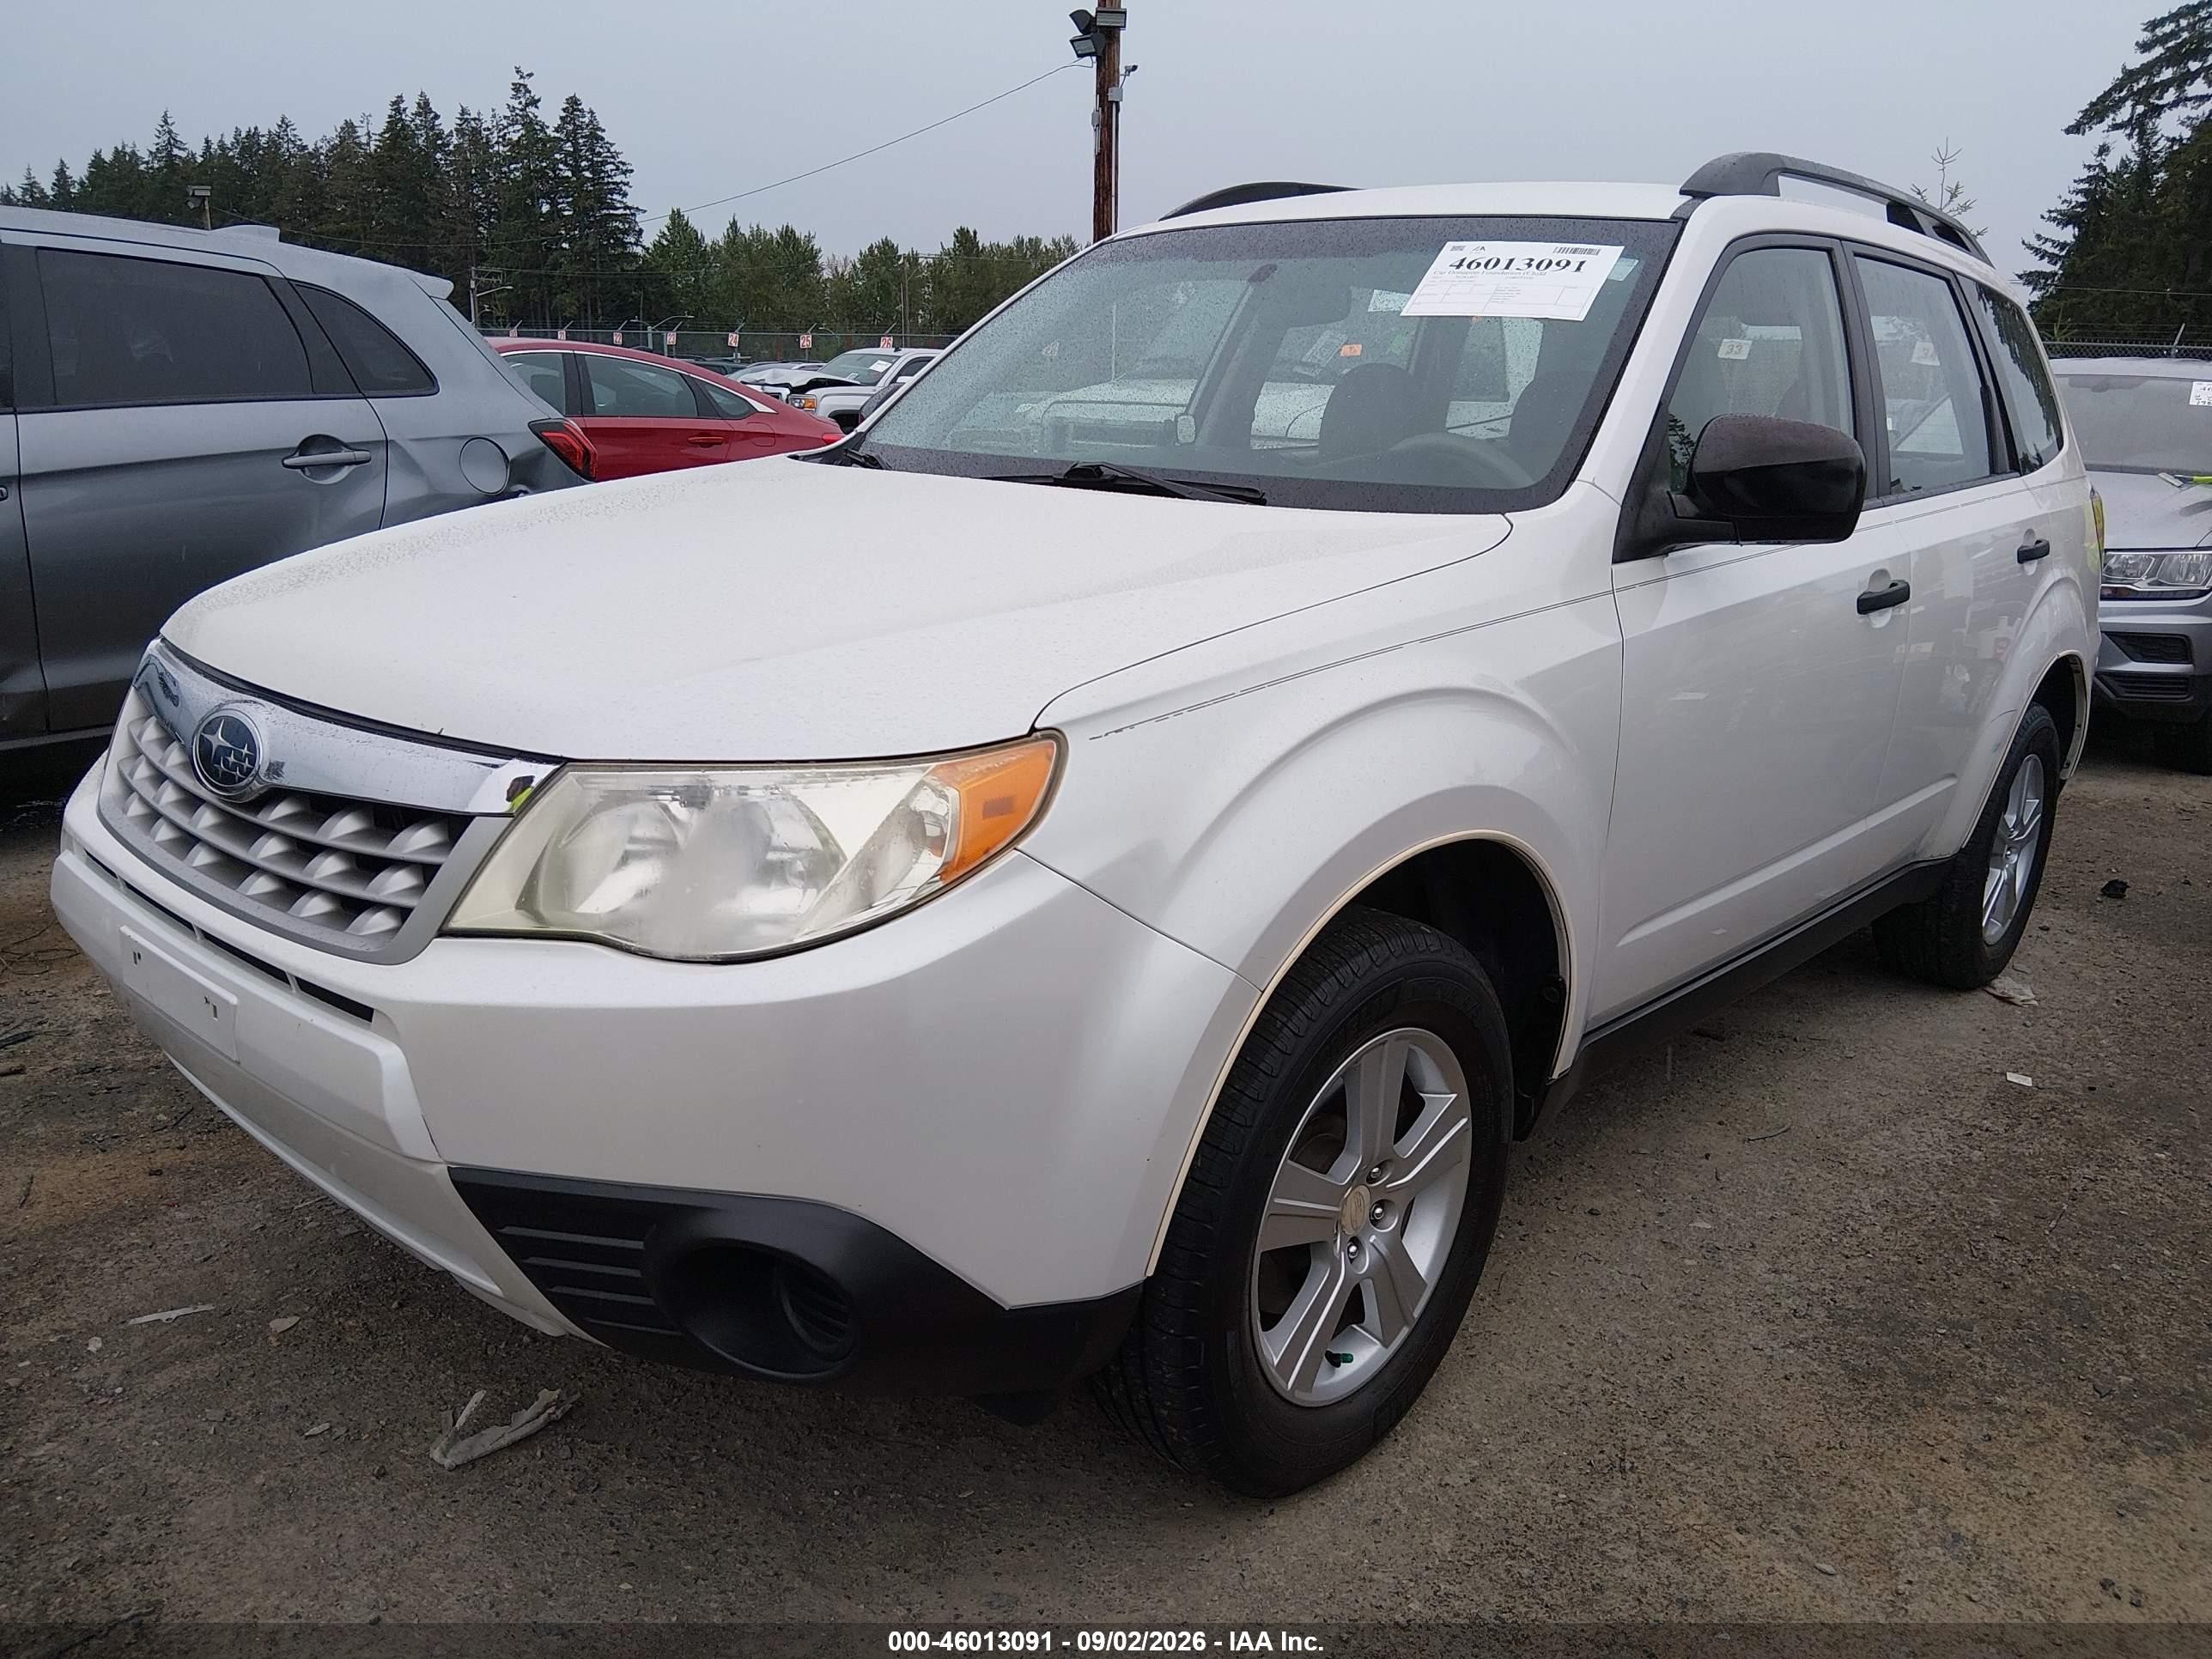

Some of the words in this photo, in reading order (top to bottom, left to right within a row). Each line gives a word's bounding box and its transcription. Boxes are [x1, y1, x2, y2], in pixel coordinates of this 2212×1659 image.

[1449, 257, 1588, 273] 46013091
[614, 332, 622, 343] 22
[668, 333, 675, 343] 23
[729, 334, 738, 346] 24
[800, 336, 811, 348] 25
[881, 337, 891, 348] 26
